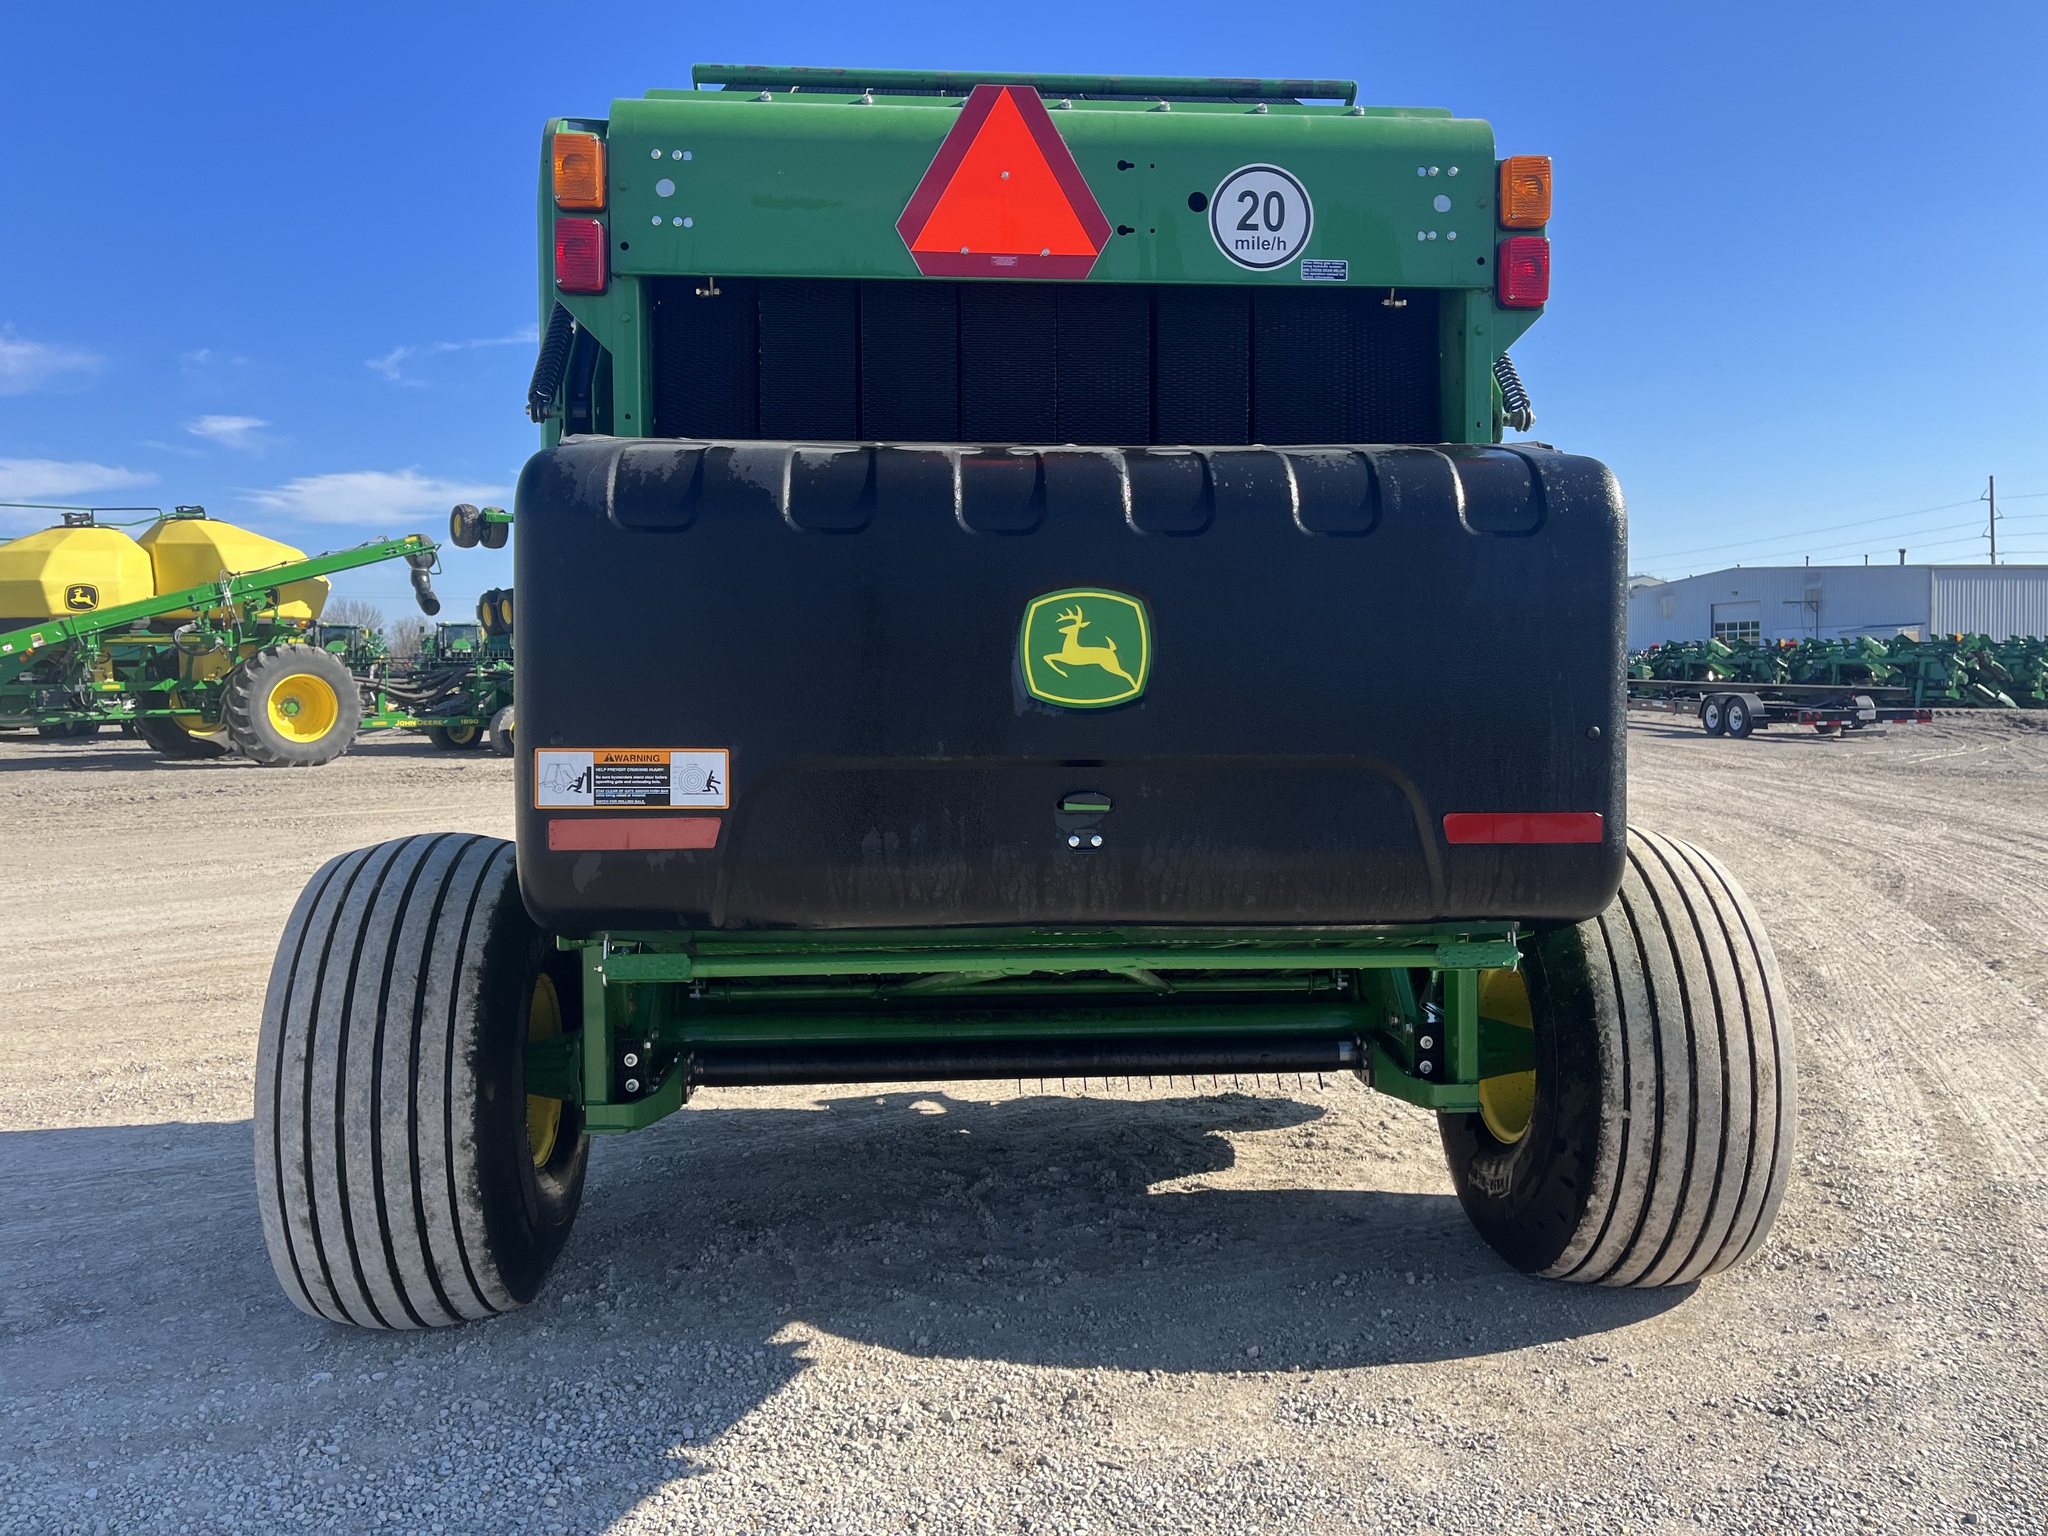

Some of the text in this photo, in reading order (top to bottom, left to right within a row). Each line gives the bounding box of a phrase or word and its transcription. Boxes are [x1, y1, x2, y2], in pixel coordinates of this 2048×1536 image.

[1236, 190, 1286, 232] 20
[1234, 236, 1287, 251] mile/h
[614, 754, 660, 762] WARNING
